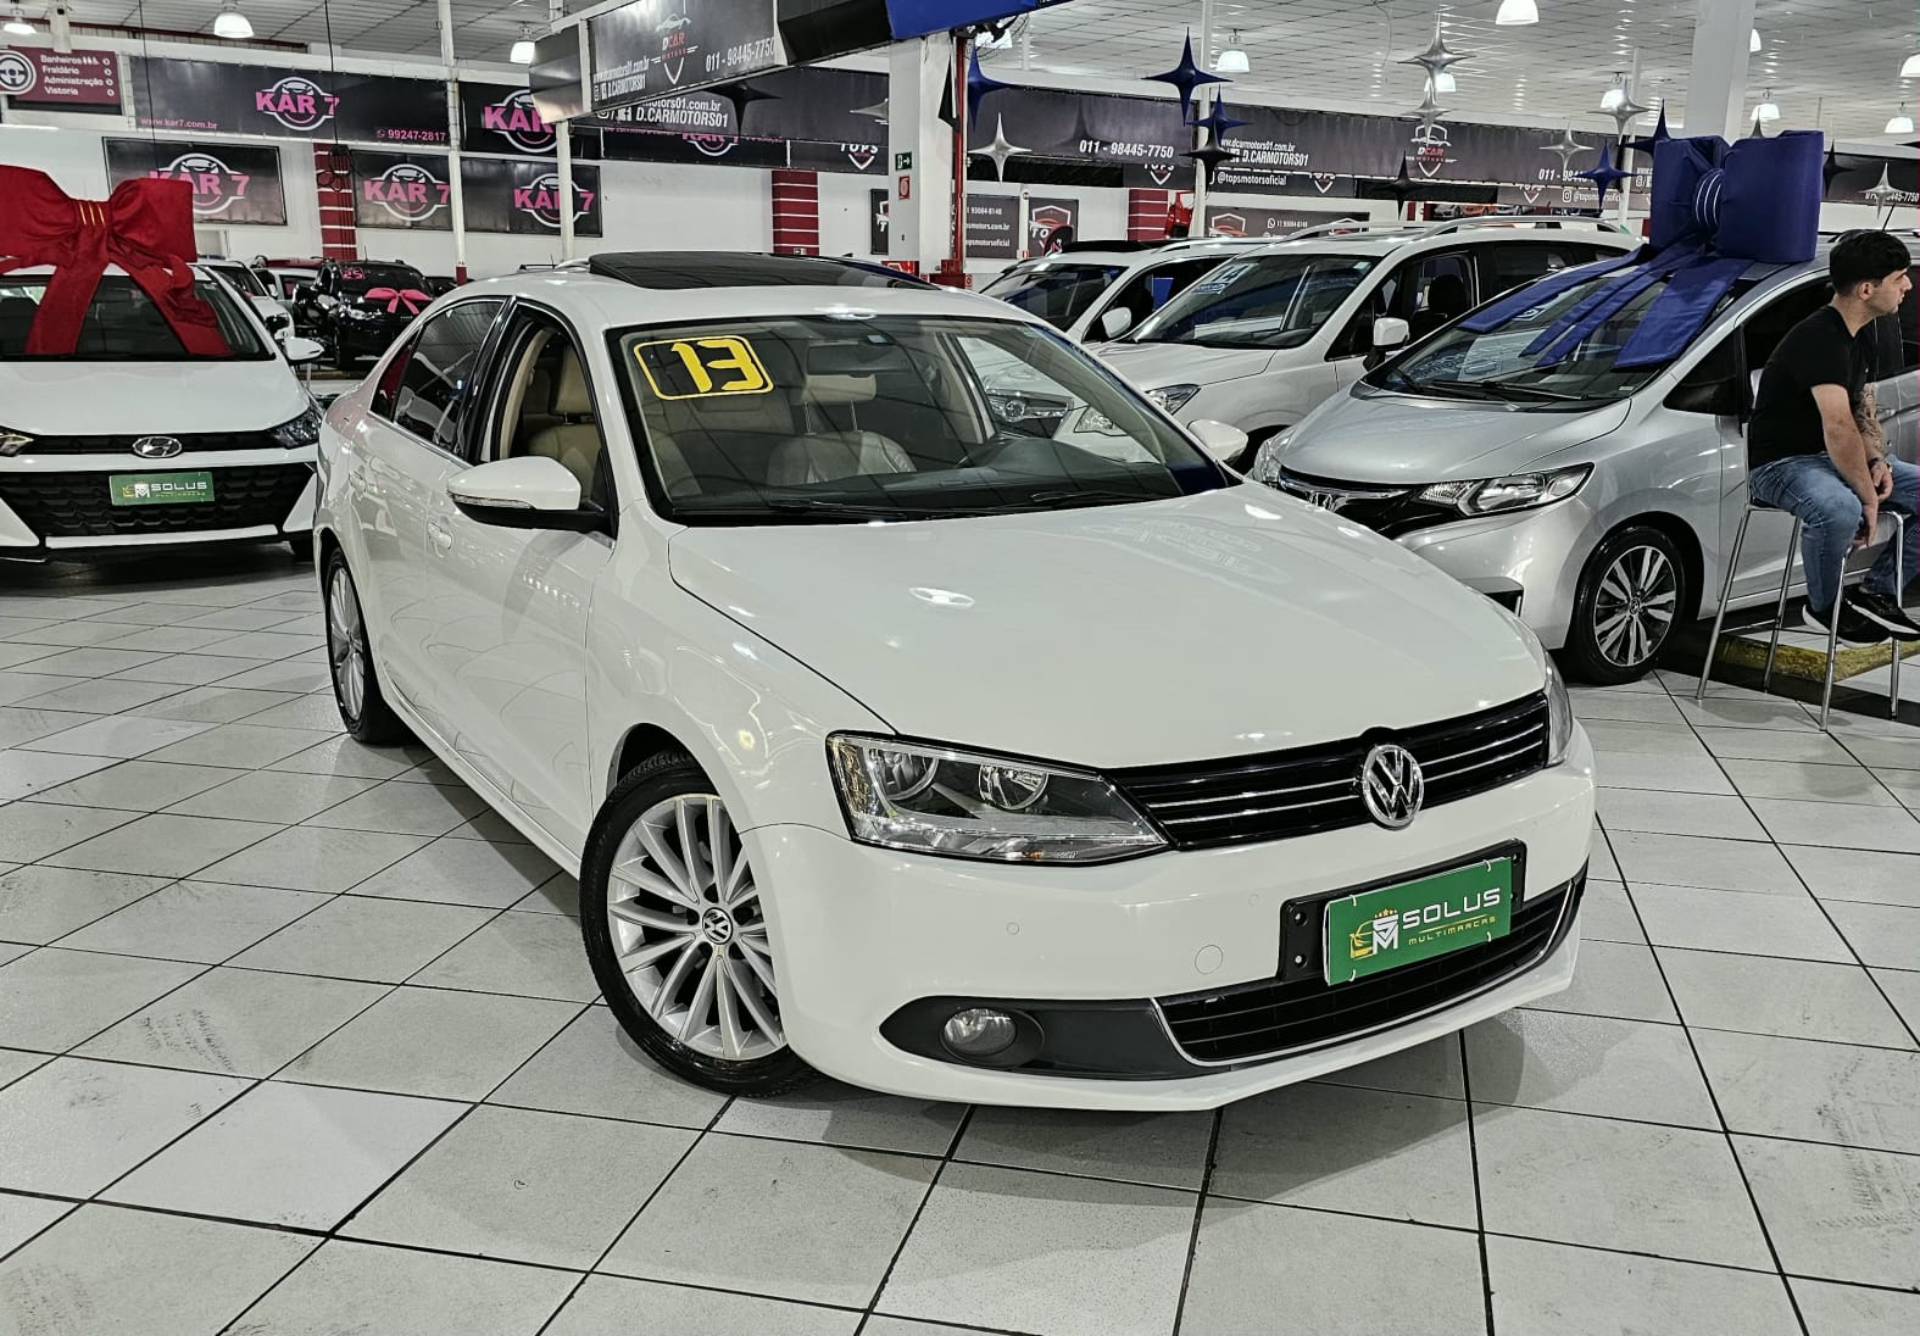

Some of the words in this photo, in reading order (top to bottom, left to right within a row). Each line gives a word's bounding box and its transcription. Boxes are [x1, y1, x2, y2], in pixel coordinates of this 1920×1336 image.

[40, 54, 82, 64] Banheiros
[706, 53, 720, 72] 011
[42, 65, 79, 75] Fraldário
[44, 76, 104, 87] Administração
[255, 91, 317, 114] KAR
[324, 97, 339, 115] 7
[636, 107, 728, 127] D.CARMOTORS01
[388, 129, 446, 141] 99247-2817
[1080, 140, 1099, 153] 011
[1110, 142, 1174, 158] 98445-7750
[1242, 150, 1308, 166] D.CARMOTORS01
[1218, 171, 1287, 186] @topsmotorsoficial
[1539, 168, 1555, 180] 011
[232, 176, 250, 196] 7
[363, 180, 428, 203] KAR
[437, 184, 450, 203] 7
[513, 188, 561, 209] KA
[580, 192, 595, 211] 7
[671, 338, 764, 393] 13
[151, 481, 207, 491] SOLUS
[1402, 887, 1500, 930] SOLUS
[1408, 914, 1496, 946] MULTIMARCAS
